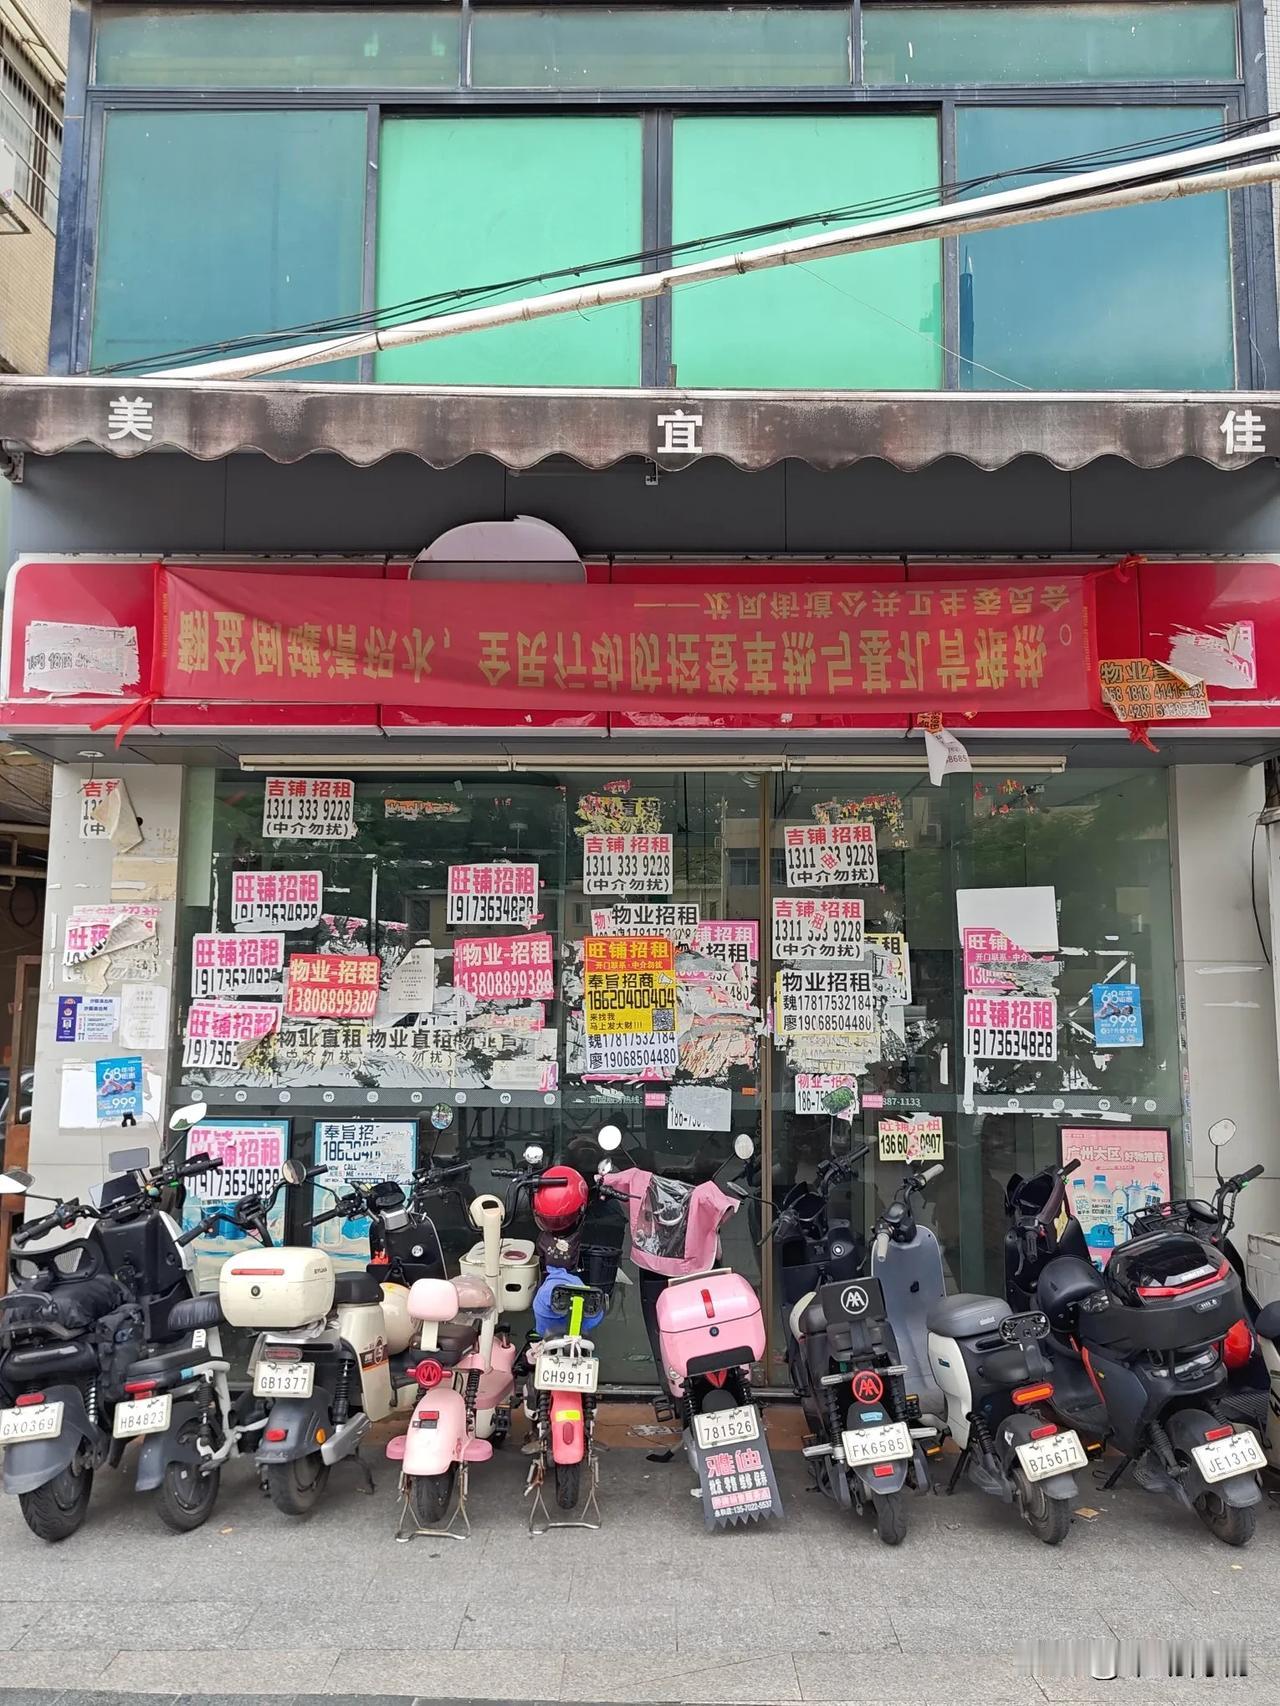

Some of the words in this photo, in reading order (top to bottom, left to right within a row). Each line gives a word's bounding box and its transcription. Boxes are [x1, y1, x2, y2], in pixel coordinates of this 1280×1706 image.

[108, 396, 153, 442] 美
[656, 410, 703, 455] 宜
[1220, 410, 1266, 455] 佳
[266, 798, 293, 820] 1311
[298, 799, 319, 820] 333
[323, 800, 350, 821] 9228
[266, 821, 349, 836] (中介勿扰)
[586, 855, 613, 876] 1311
[617, 855, 638, 876] 333
[643, 855, 670, 876] 9228
[788, 847, 816, 869] 1311
[846, 844, 875, 867] 9228
[235, 874, 319, 902] 旺铺招租
[451, 866, 535, 894] 旺铺招租
[586, 878, 669, 892] (中介勿扰)
[612, 905, 699, 926] 物业招租
[775, 919, 802, 941] 1311
[833, 920, 862, 942] 9228
[195, 938, 280, 967] 旺铺招租
[588, 940, 670, 960] 旺铺招租
[588, 972, 655, 990] 奉旨招商
[783, 972, 871, 993] 物业招租
[287, 986, 377, 1014] 13808899380
[966, 998, 1053, 1029] 旺铺招租
[1109, 1015, 1137, 1027] 999
[967, 1028, 1053, 1058] 19173634828
[112, 1096, 137, 1108] 999
[324, 1124, 375, 1141] 奉旨招
[1065, 1144, 1122, 1162] 广州大区
[260, 1376, 307, 1390] GB1377
[703, 1420, 752, 1441] 781526
[852, 1436, 905, 1458] FK6585
[1028, 1446, 1079, 1474] BZ5677
[1208, 1447, 1258, 1475] JE1319
